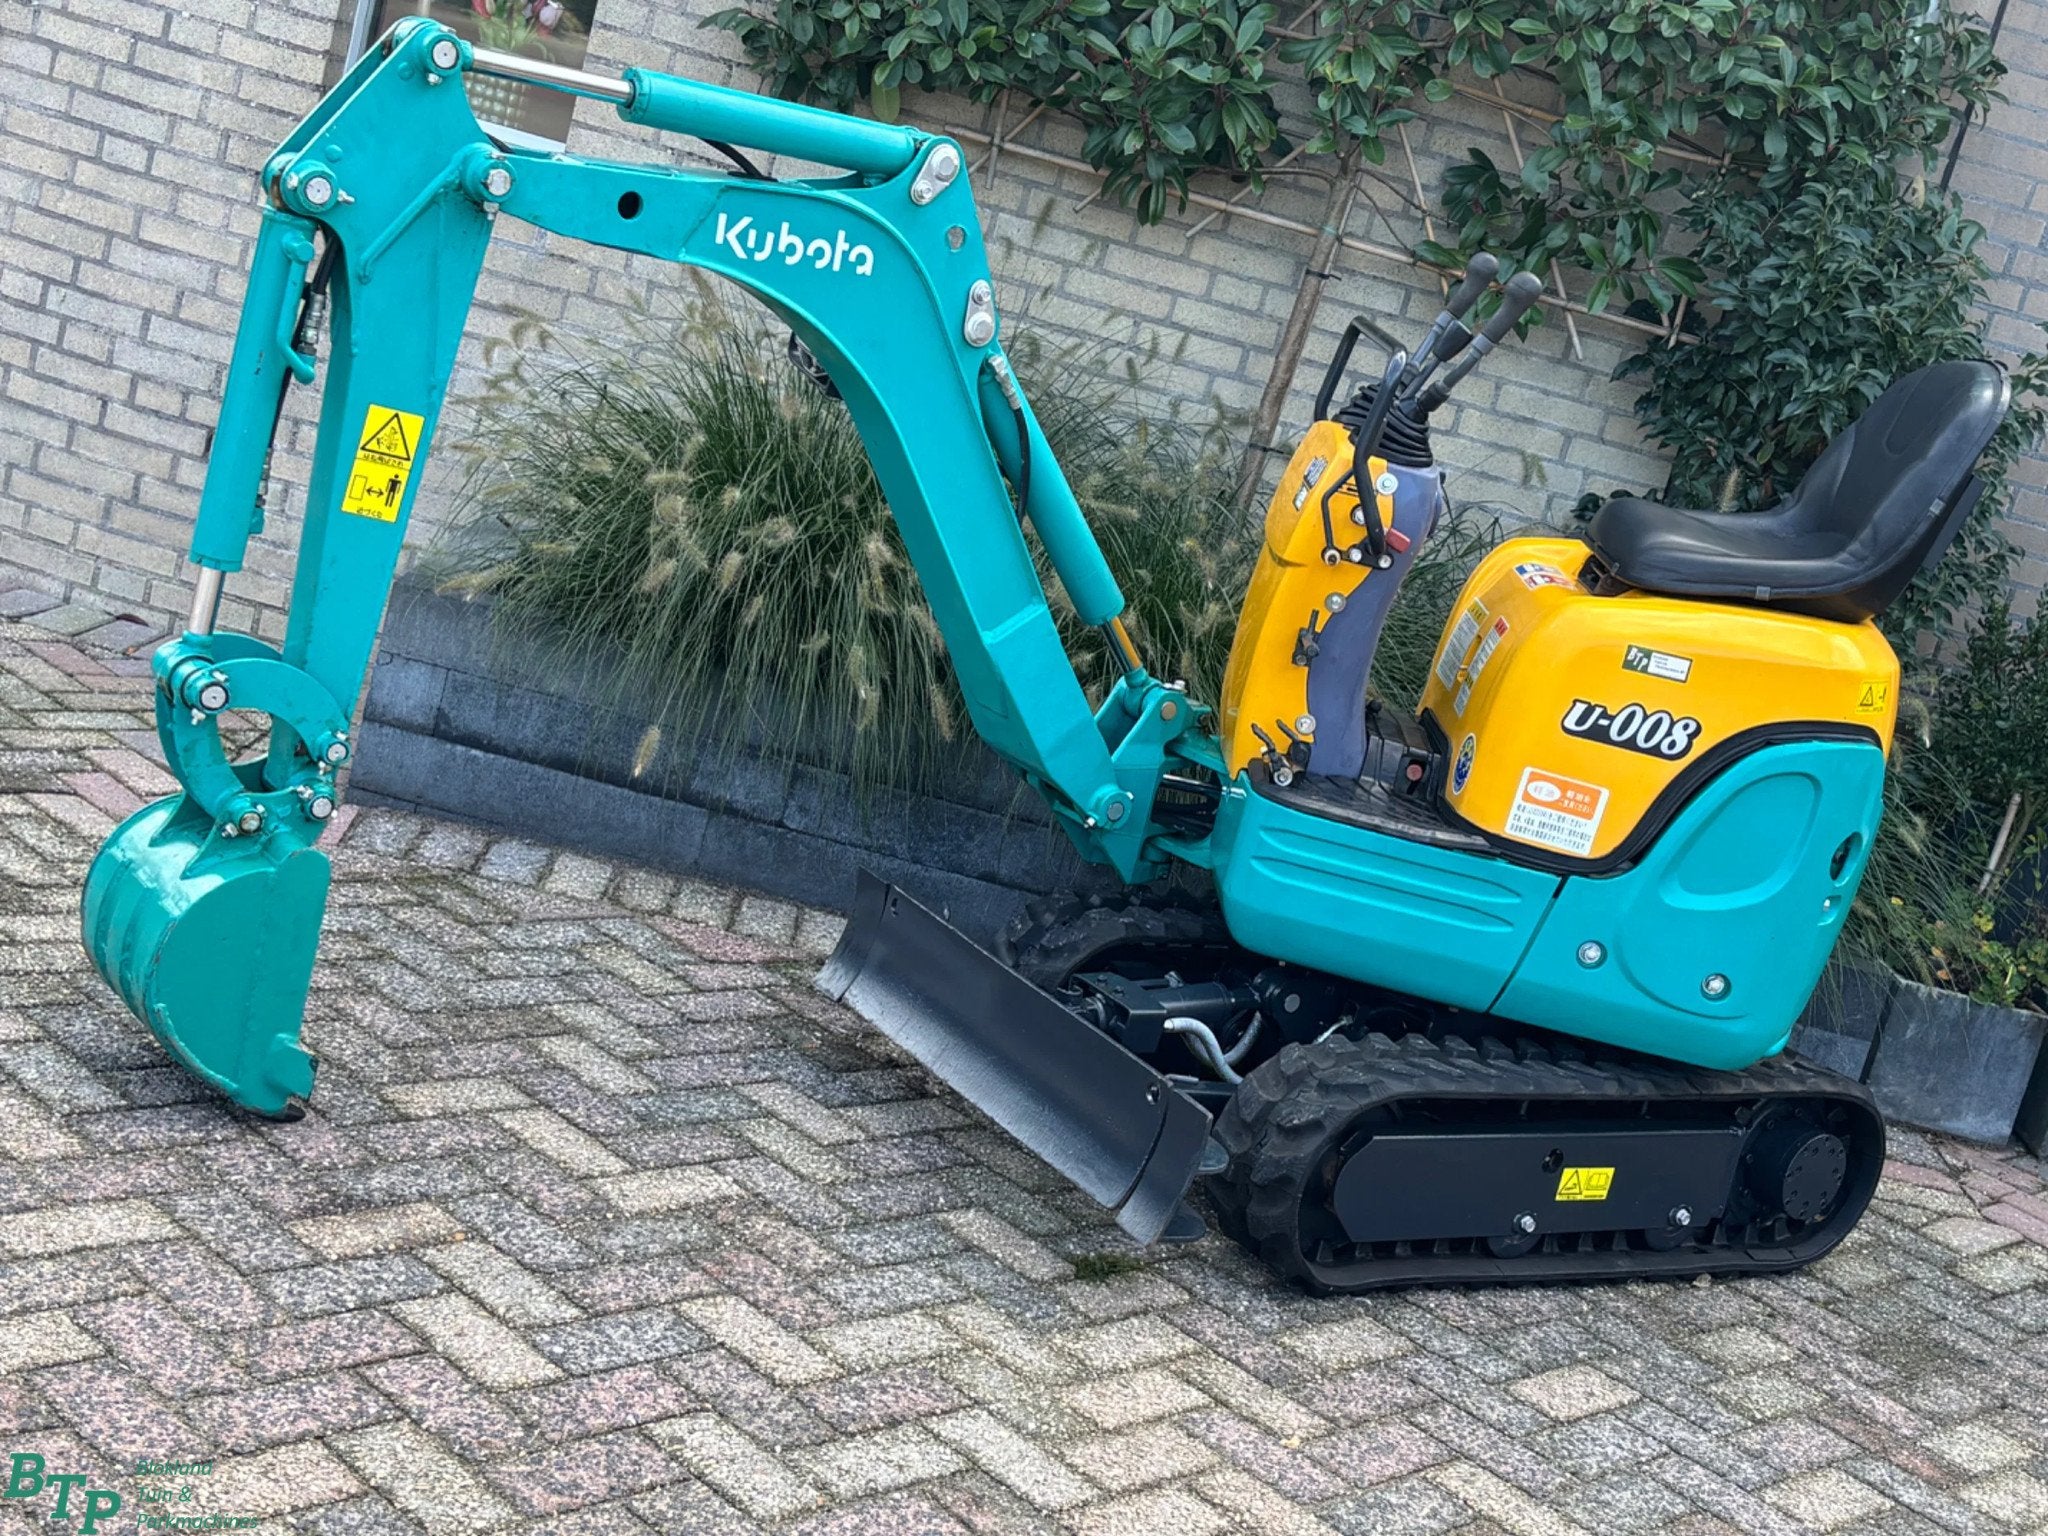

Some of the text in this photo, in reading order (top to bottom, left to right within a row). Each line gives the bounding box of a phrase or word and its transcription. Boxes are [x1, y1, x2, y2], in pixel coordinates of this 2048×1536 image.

[715, 212, 874, 276] Kubota
[1627, 647, 1649, 671] BTP
[1562, 701, 1698, 755] U-008
